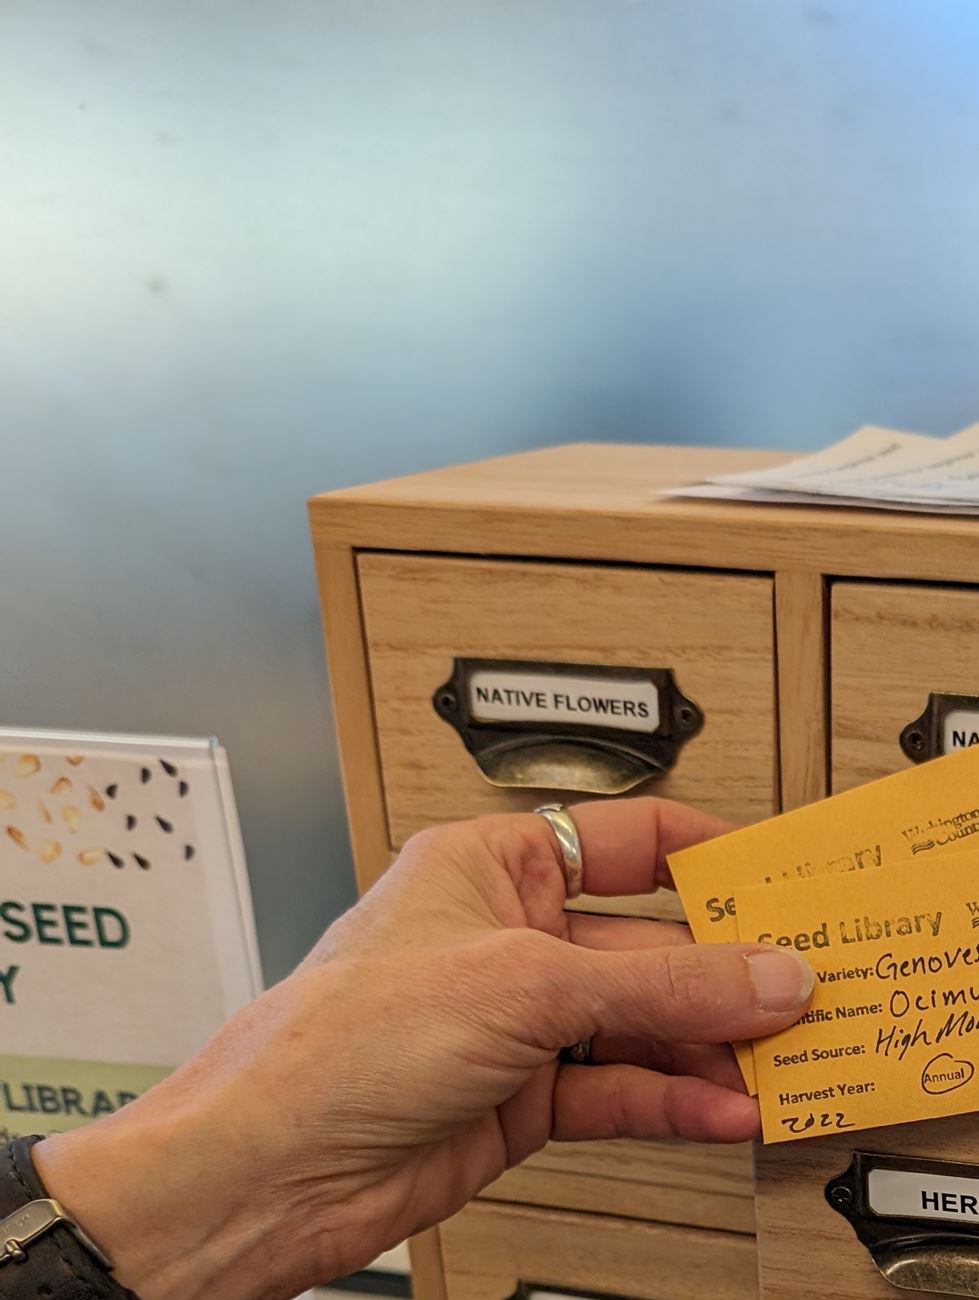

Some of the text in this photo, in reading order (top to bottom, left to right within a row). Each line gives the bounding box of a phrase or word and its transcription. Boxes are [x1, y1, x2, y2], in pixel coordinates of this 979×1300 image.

[476, 687, 650, 718] NATIVE FLOWERS
[706, 897, 737, 922] Se
[0, 900, 131, 949] SEED
[839, 912, 943, 944] Library
[816, 967, 875, 984] Variety:
[835, 1003, 883, 1020] Name:
[875, 1019, 932, 1060] High
[773, 1042, 866, 1068] Seed Source:
[923, 1067, 965, 1084] Annual
[0, 1080, 140, 1118] LIBRA
[778, 1081, 876, 1106] Harvest Year:
[781, 1113, 856, 1133] 2022
